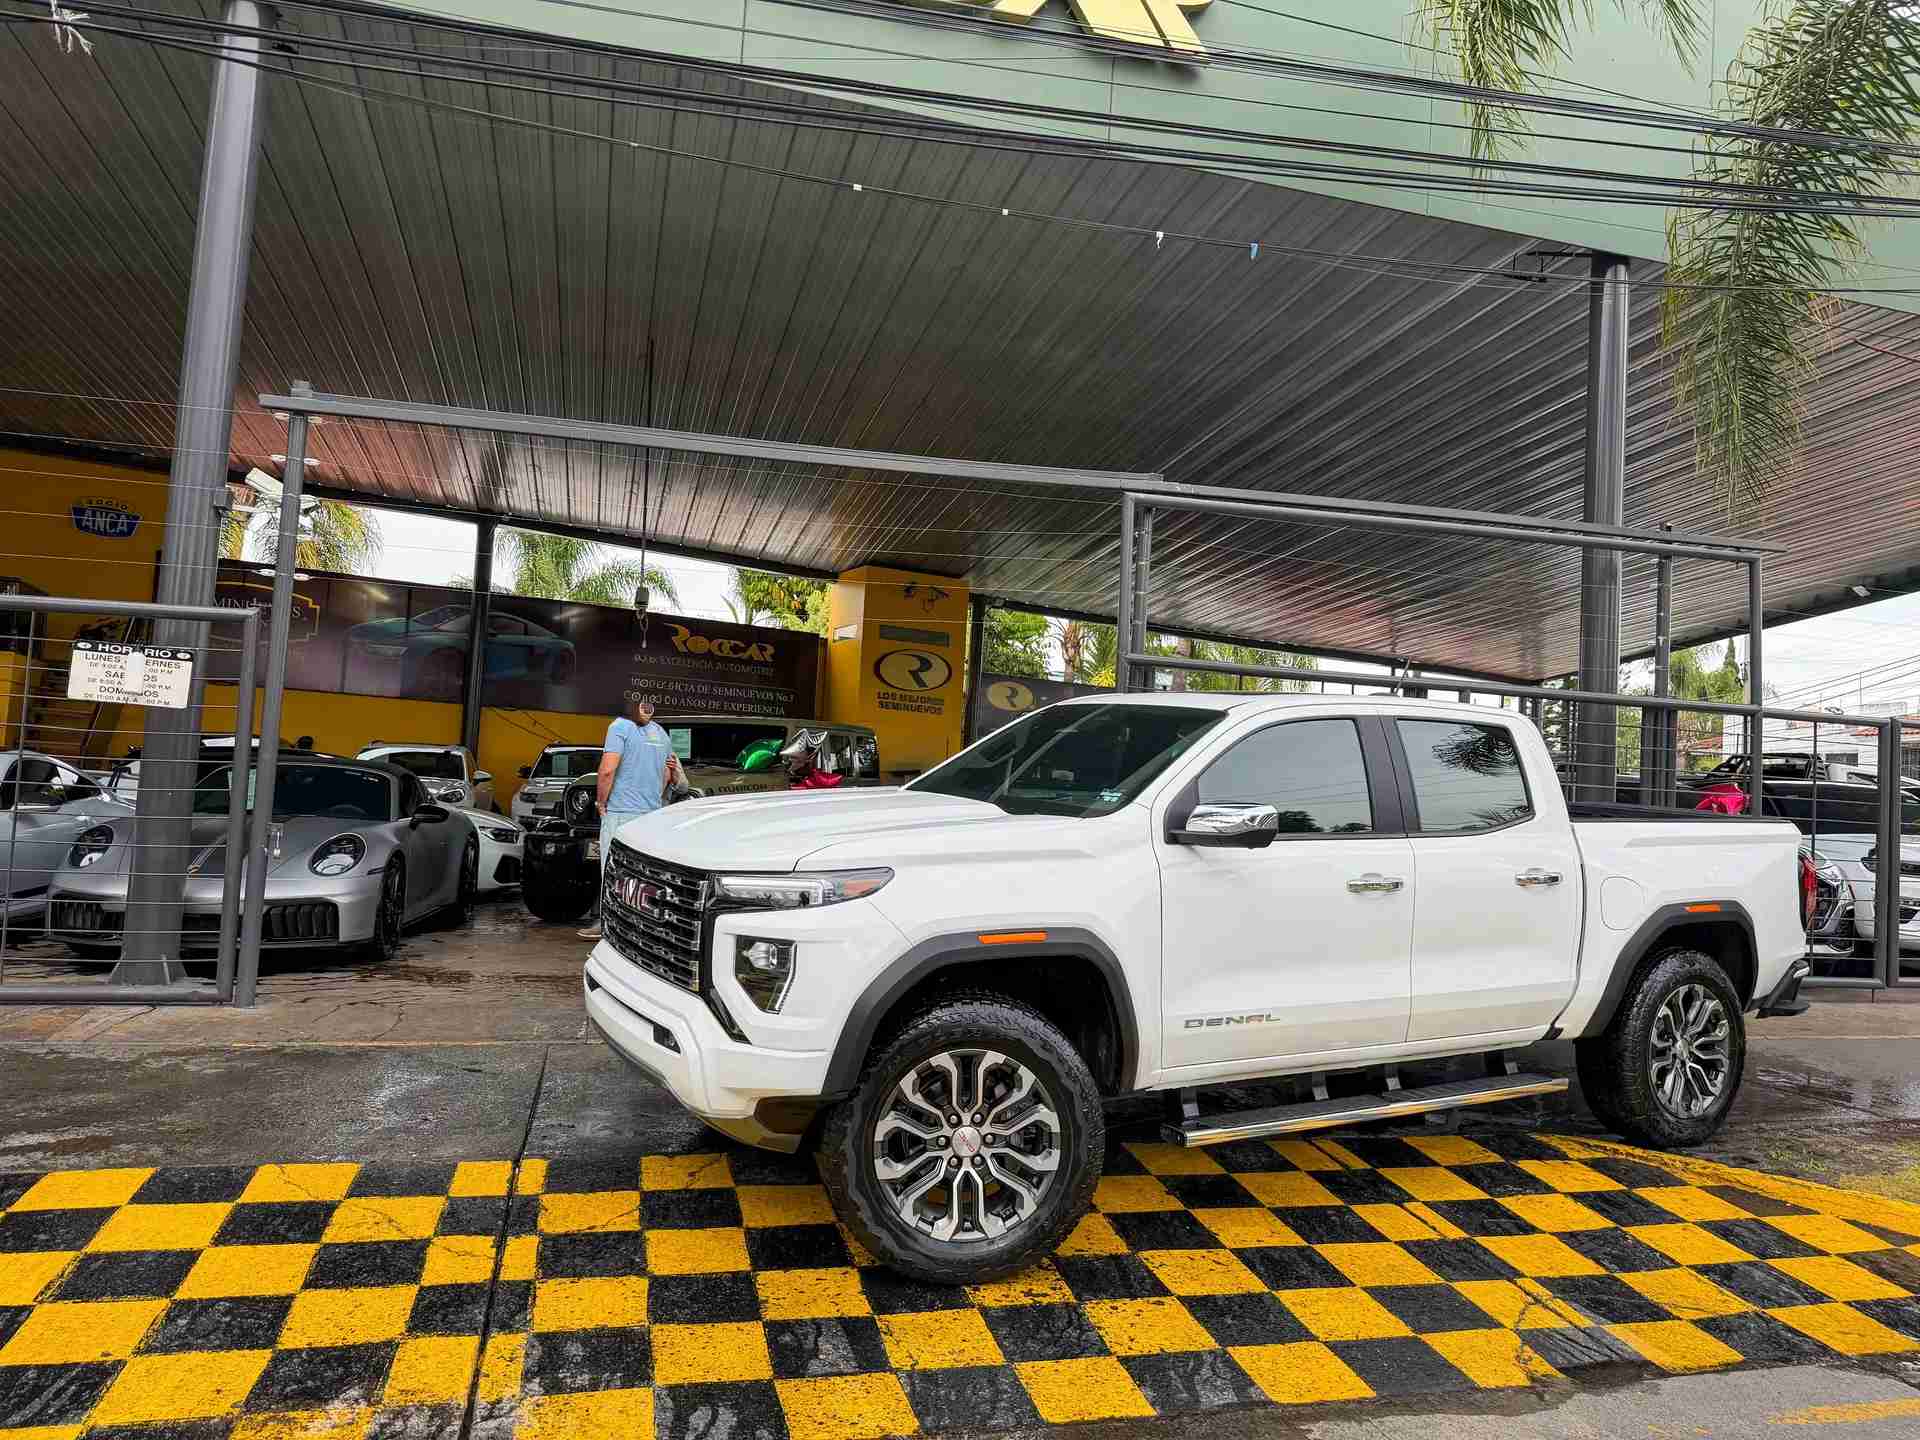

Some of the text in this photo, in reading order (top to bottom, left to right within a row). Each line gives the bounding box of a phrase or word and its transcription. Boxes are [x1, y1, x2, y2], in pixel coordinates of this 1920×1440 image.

[82, 509, 128, 533] ANCA
[665, 623, 775, 662] ROCCAR
[85, 653, 121, 663] LUNES
[98, 643, 172, 658] HORRIO
[99, 685, 159, 698] DOMOS
[712, 686, 775, 701] SEMINUEVOS
[899, 693, 945, 706] MEJO
[723, 700, 785, 715] EXPERIENCIA
[877, 700, 943, 716] SEMINUEVOS
